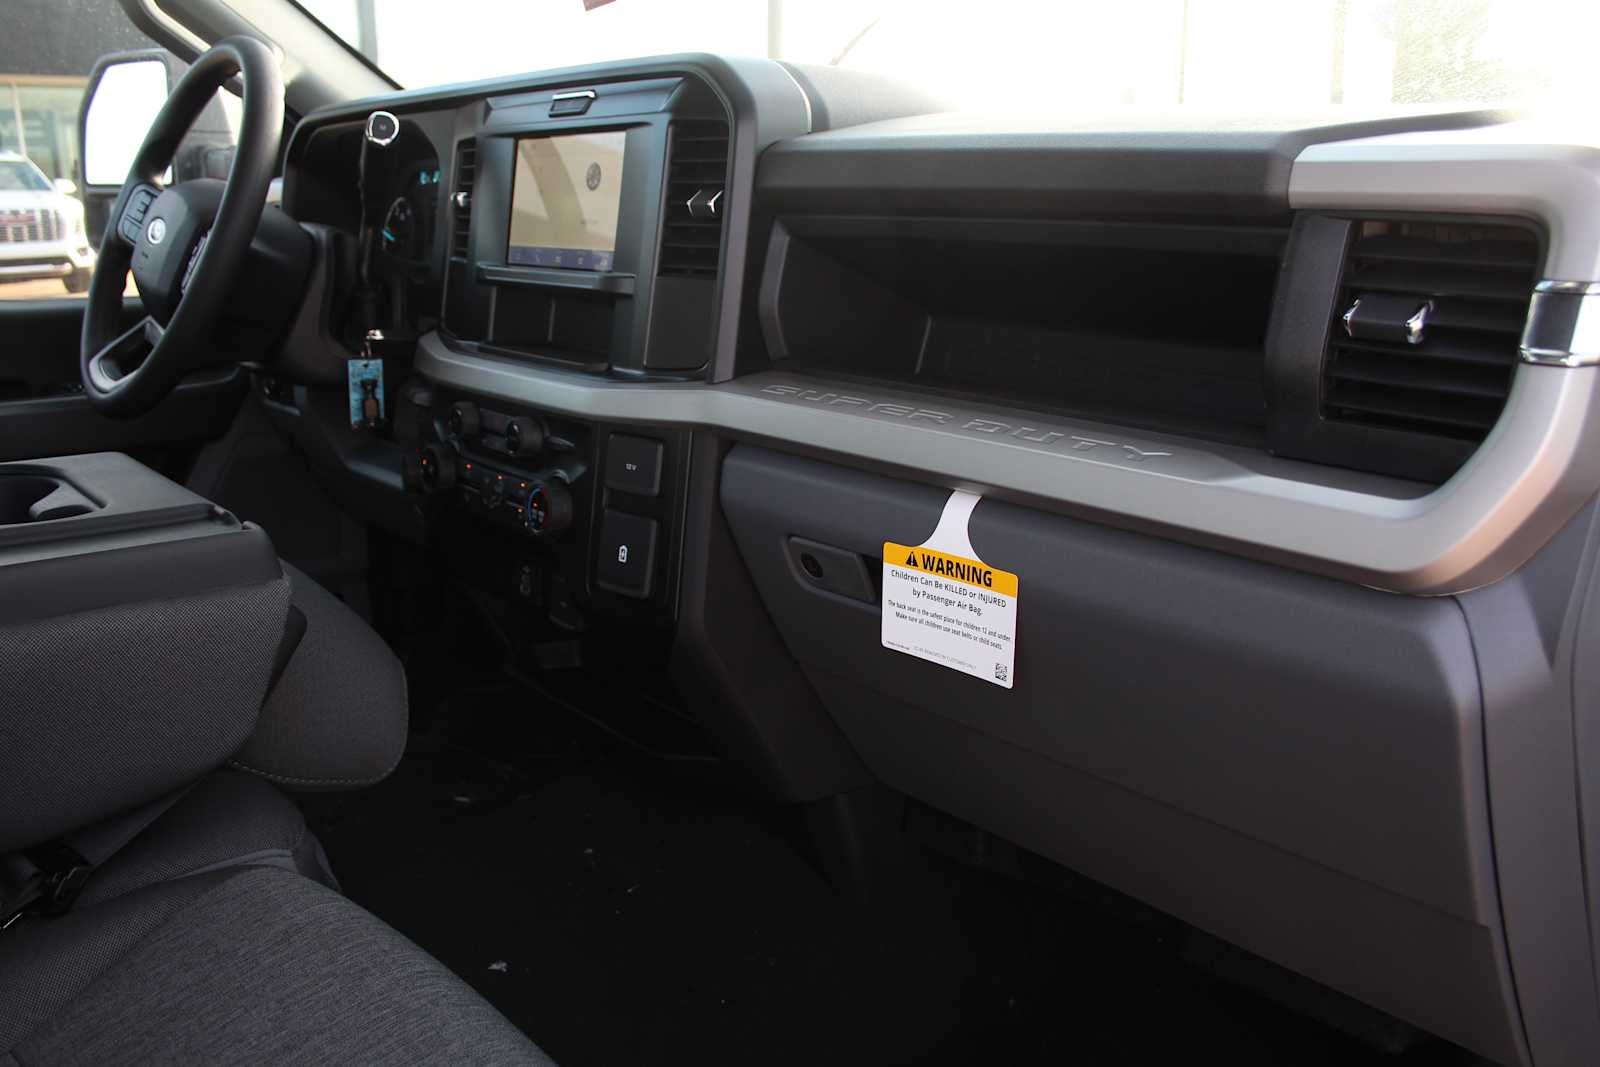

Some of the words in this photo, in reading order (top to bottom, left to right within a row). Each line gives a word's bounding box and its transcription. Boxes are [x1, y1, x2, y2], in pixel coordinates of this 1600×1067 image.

[760, 384, 955, 425] SUPER
[962, 418, 1173, 461] DUTY
[922, 554, 992, 587] WARNING
[891, 570, 918, 583] Children
[920, 577, 932, 587] Can
[934, 580, 943, 590] Be
[944, 584, 967, 596] KILLED
[969, 589, 977, 598] or
[978, 593, 1006, 608] INJURED
[913, 588, 921, 599] by
[922, 591, 955, 608] Passenger
[958, 599, 966, 609] Air
[969, 604, 982, 616] Bag.
[896, 602, 906, 611] back
[930, 612, 942, 621] safest
[943, 616, 955, 624] place
[963, 620, 980, 632] children
[896, 612, 907, 621] Make
[925, 618, 942, 631] children
[952, 626, 961, 635] seat
[961, 630, 972, 639] belts
[979, 634, 989, 645] child
